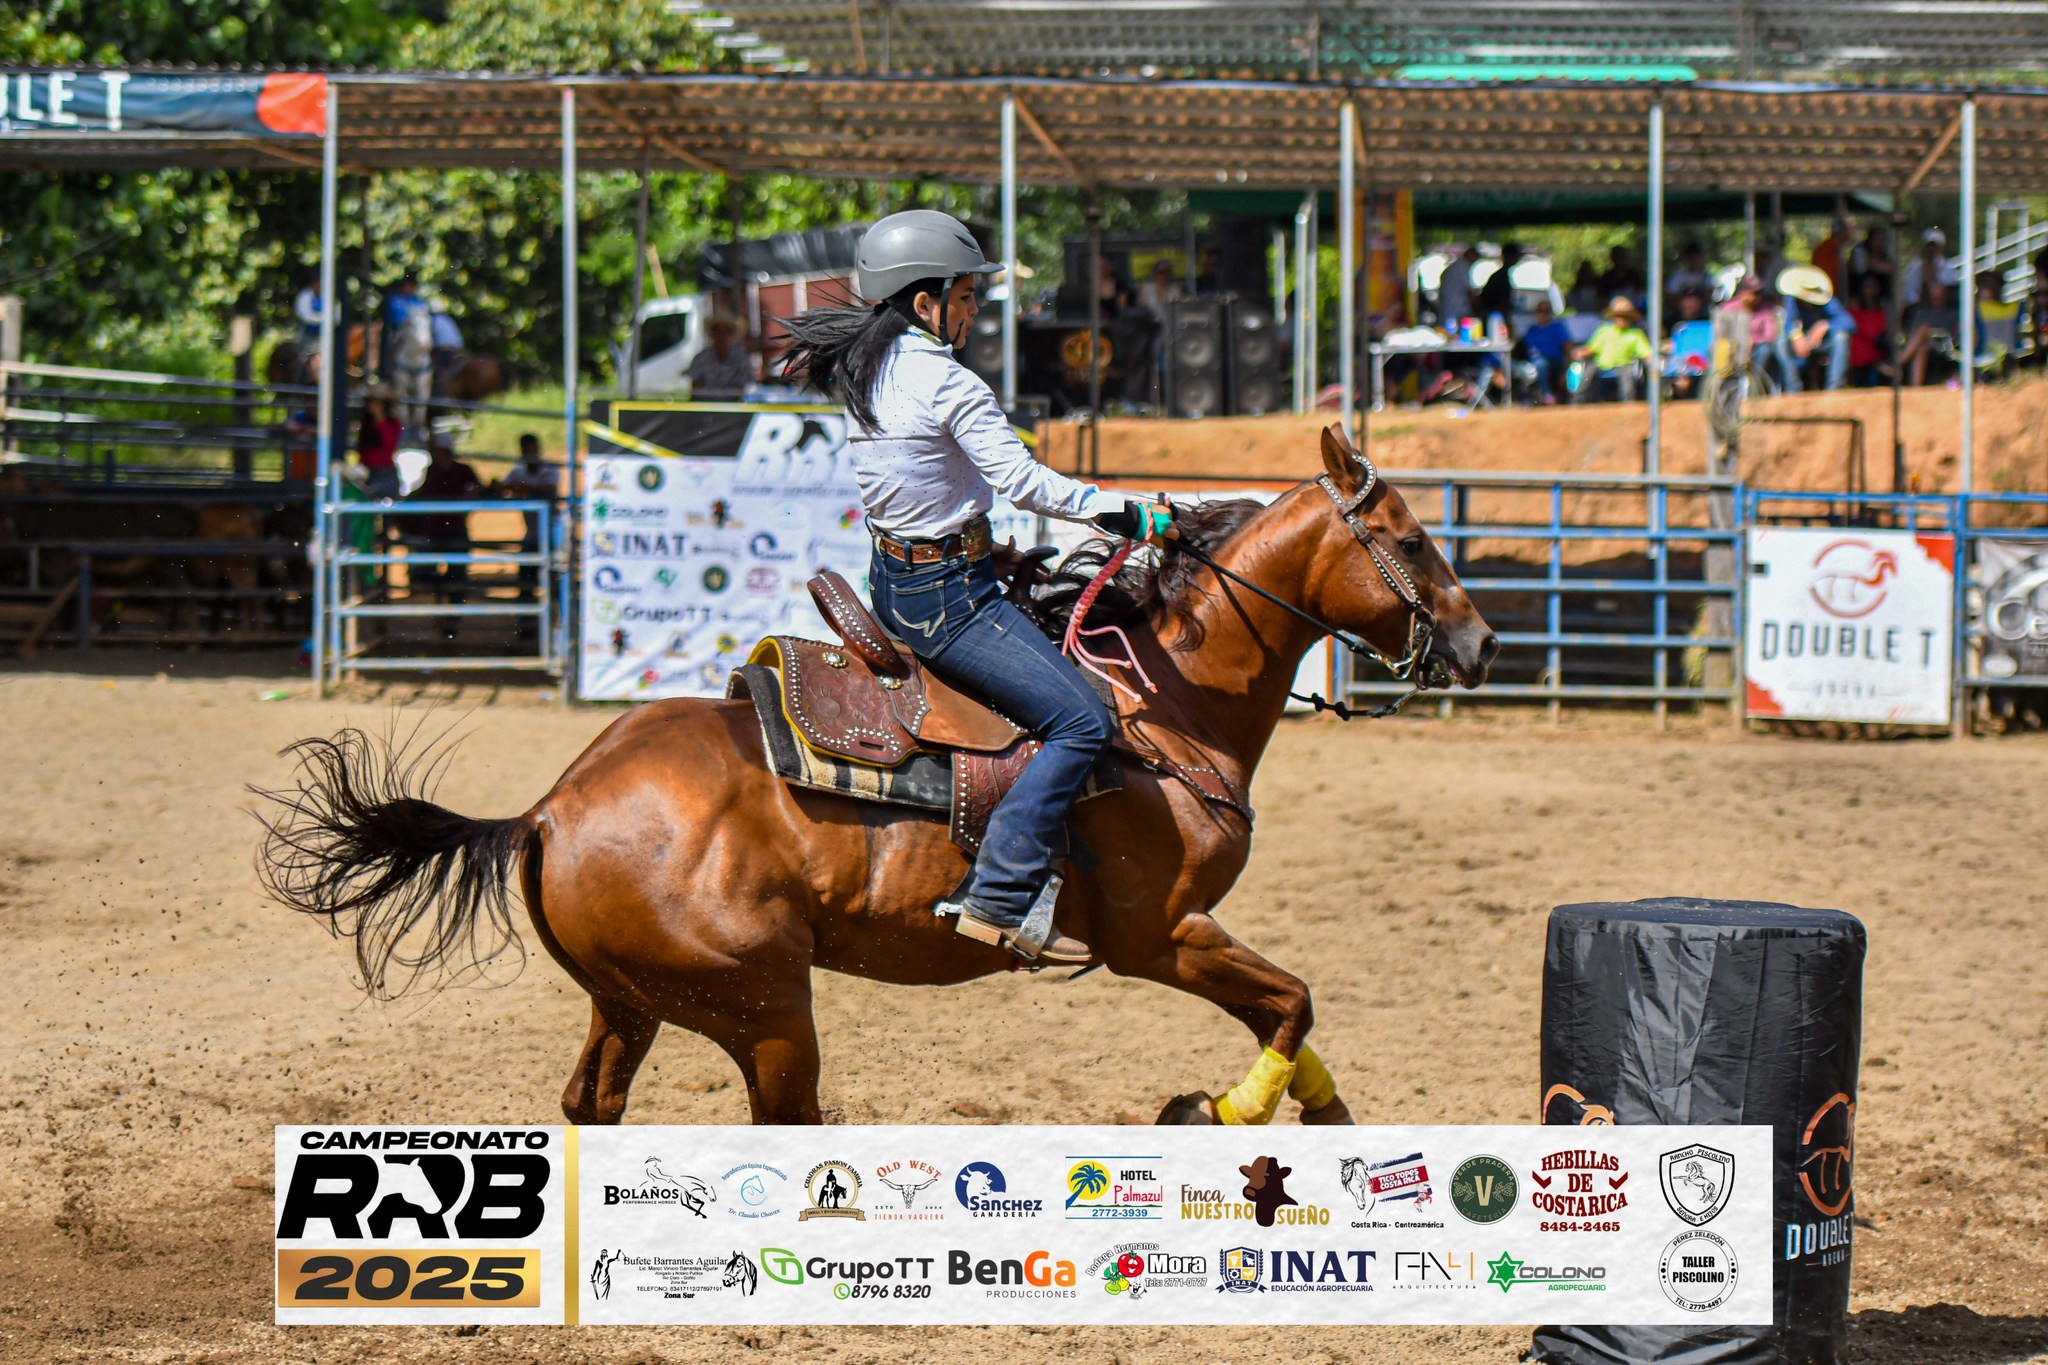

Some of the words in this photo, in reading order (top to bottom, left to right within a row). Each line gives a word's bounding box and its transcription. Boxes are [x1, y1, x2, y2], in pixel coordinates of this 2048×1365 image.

[99, 71, 130, 131] T
[623, 533, 687, 555] INAT
[1762, 621, 1900, 662] DOUBLE
[1920, 629, 1936, 669] T
[1786, 1214, 1850, 1260] DOUBLE
